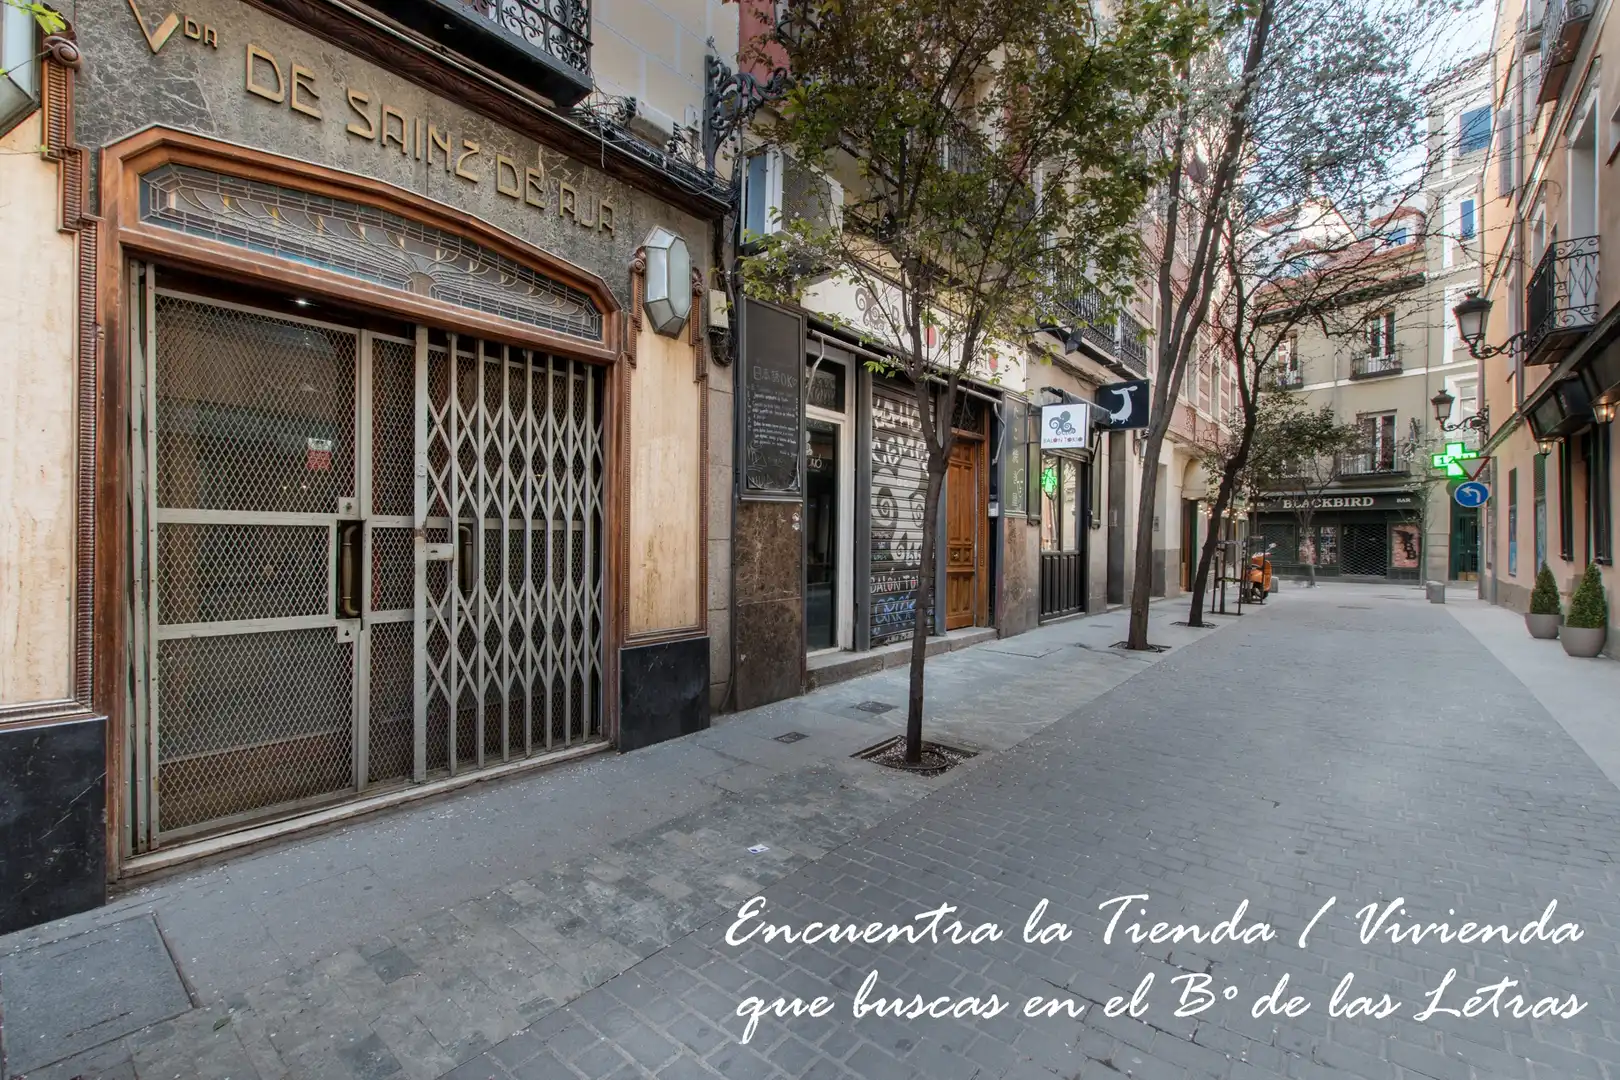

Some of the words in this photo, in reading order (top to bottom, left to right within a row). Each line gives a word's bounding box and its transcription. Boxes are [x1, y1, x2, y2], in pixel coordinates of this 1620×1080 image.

[246, 43, 321, 120] DE
[346, 87, 480, 183] SAINZ
[496, 152, 546, 209] DE
[1282, 496, 1375, 509] BLACKBIRD
